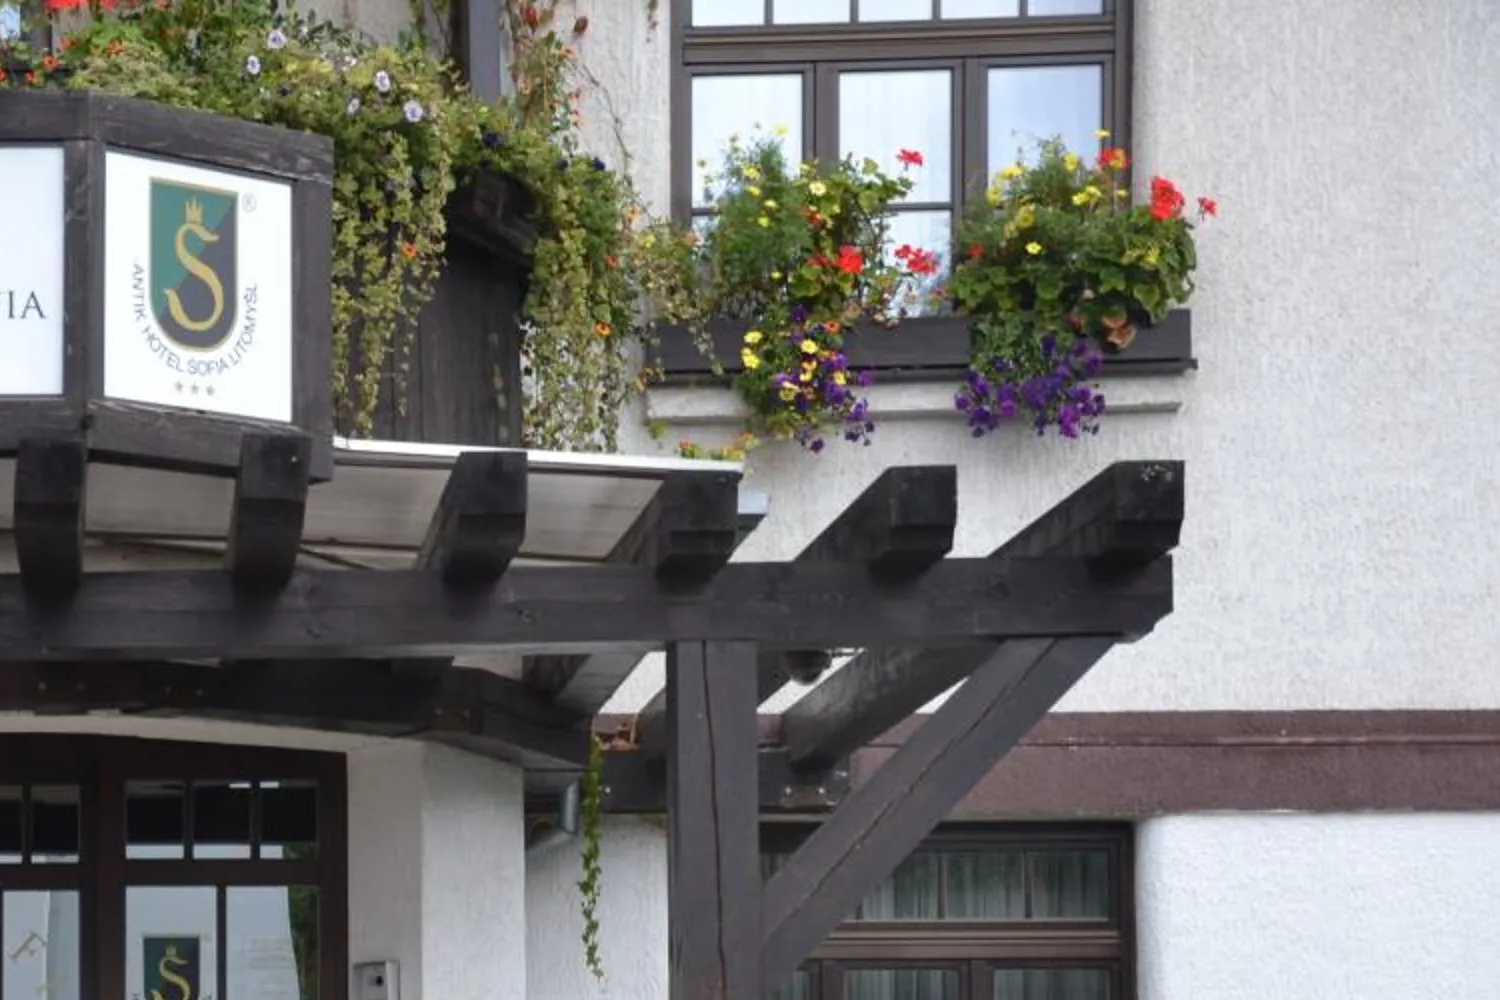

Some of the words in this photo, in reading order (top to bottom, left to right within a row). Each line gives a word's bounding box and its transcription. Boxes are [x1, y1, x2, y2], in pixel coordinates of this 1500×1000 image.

[131, 263, 147, 322] ANTIK
[143, 323, 184, 373] HOTEL
[186, 357, 232, 377] SOFIA
